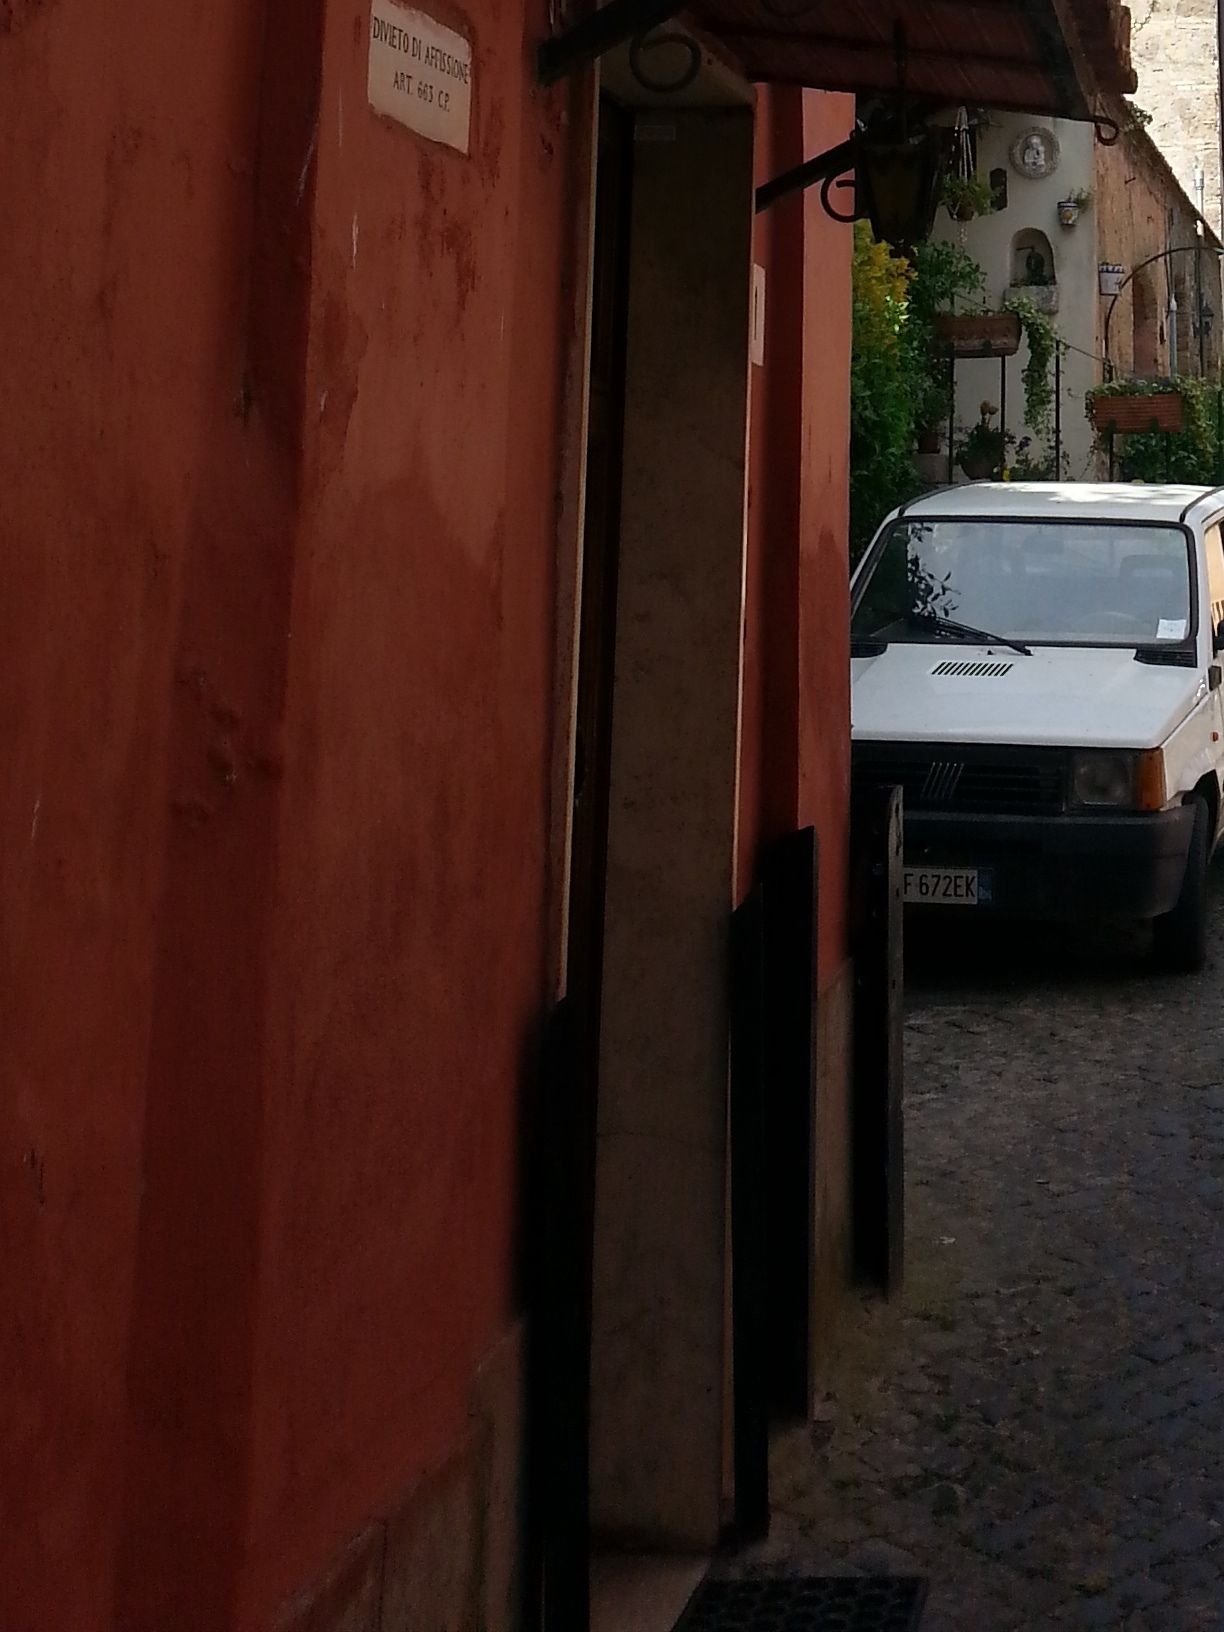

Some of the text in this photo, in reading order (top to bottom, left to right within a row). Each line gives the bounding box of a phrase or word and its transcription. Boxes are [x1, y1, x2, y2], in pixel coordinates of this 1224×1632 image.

[373, 17, 469, 84] DIVIETO DI AFFISSIONE
[393, 70, 414, 95] ART.
[417, 81, 434, 103] 663
[919, 874, 976, 898] 672EK
